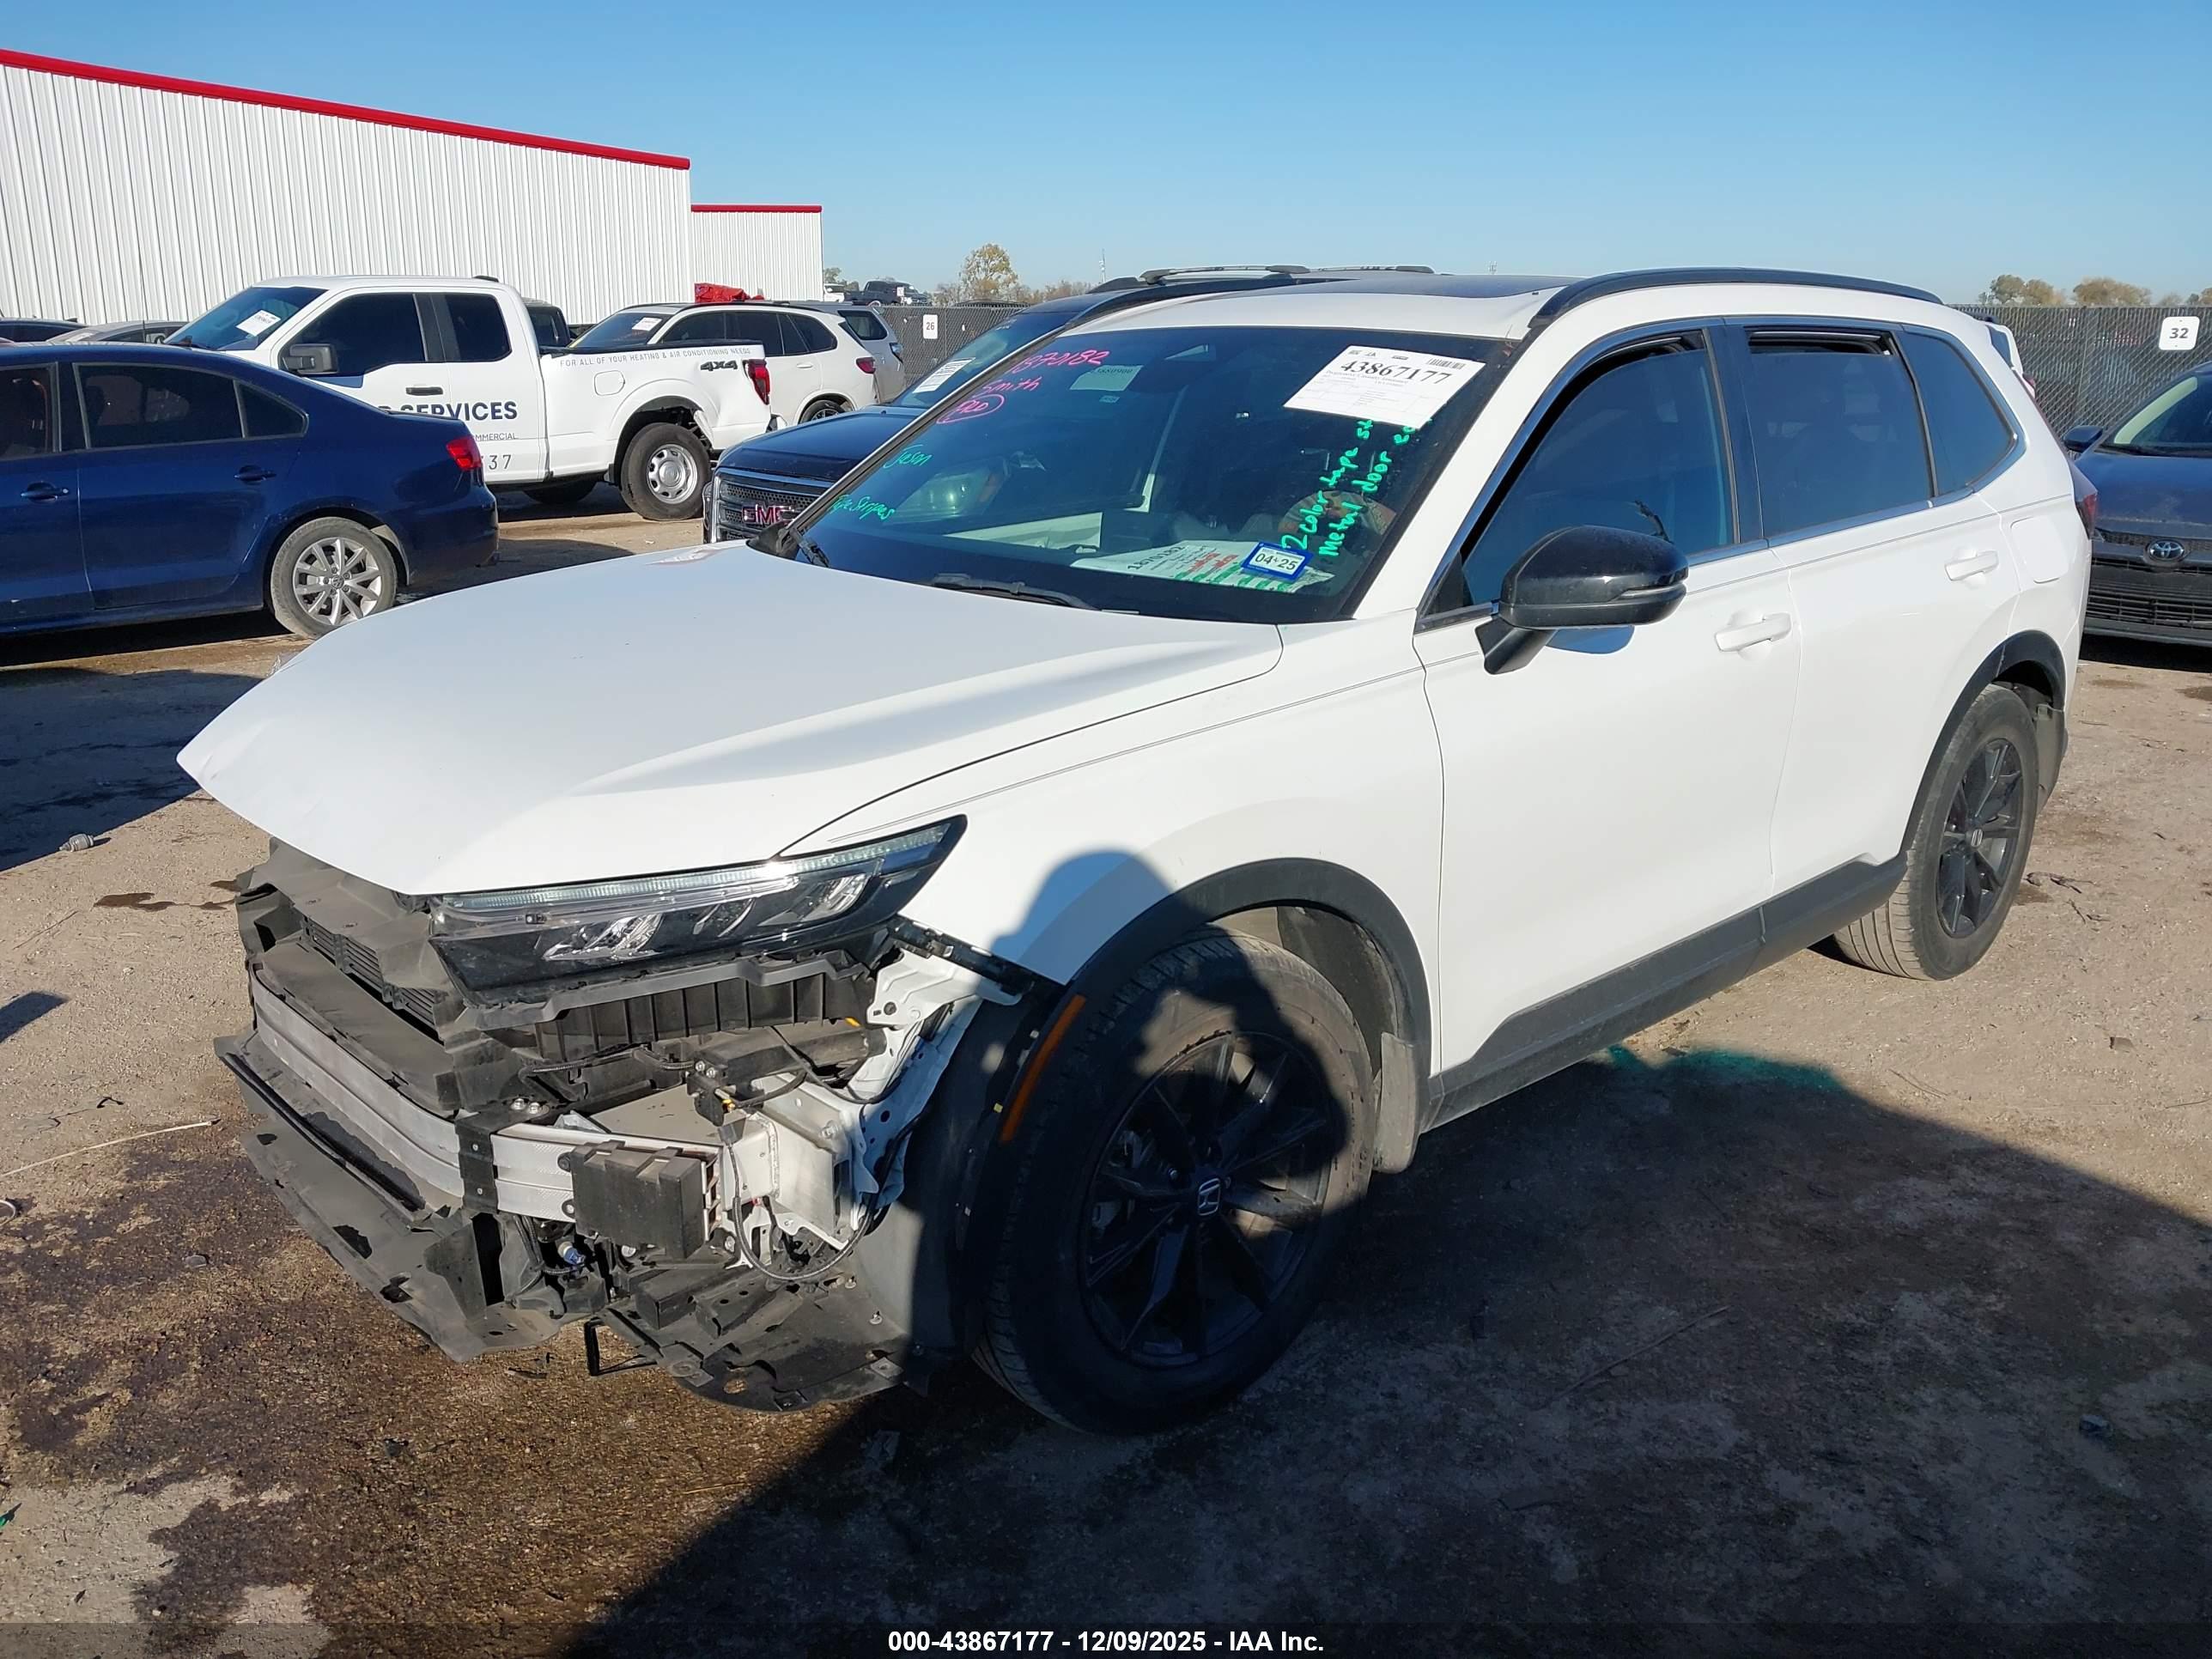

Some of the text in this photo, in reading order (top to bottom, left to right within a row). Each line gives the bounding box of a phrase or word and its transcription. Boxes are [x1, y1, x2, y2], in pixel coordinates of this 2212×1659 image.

[926, 322, 935, 331] 26
[2169, 327, 2189, 339] 32
[560, 359, 576, 368] FOR
[629, 352, 659, 362] HEATING
[1340, 361, 1452, 384] 43867177
[474, 433, 516, 441] MMERCIAL
[1352, 451, 1392, 492] door
[742, 501, 794, 526] GMC
[1281, 534, 1308, 550] 2
[1255, 553, 1273, 565] 04
[1277, 558, 1298, 570] 25
